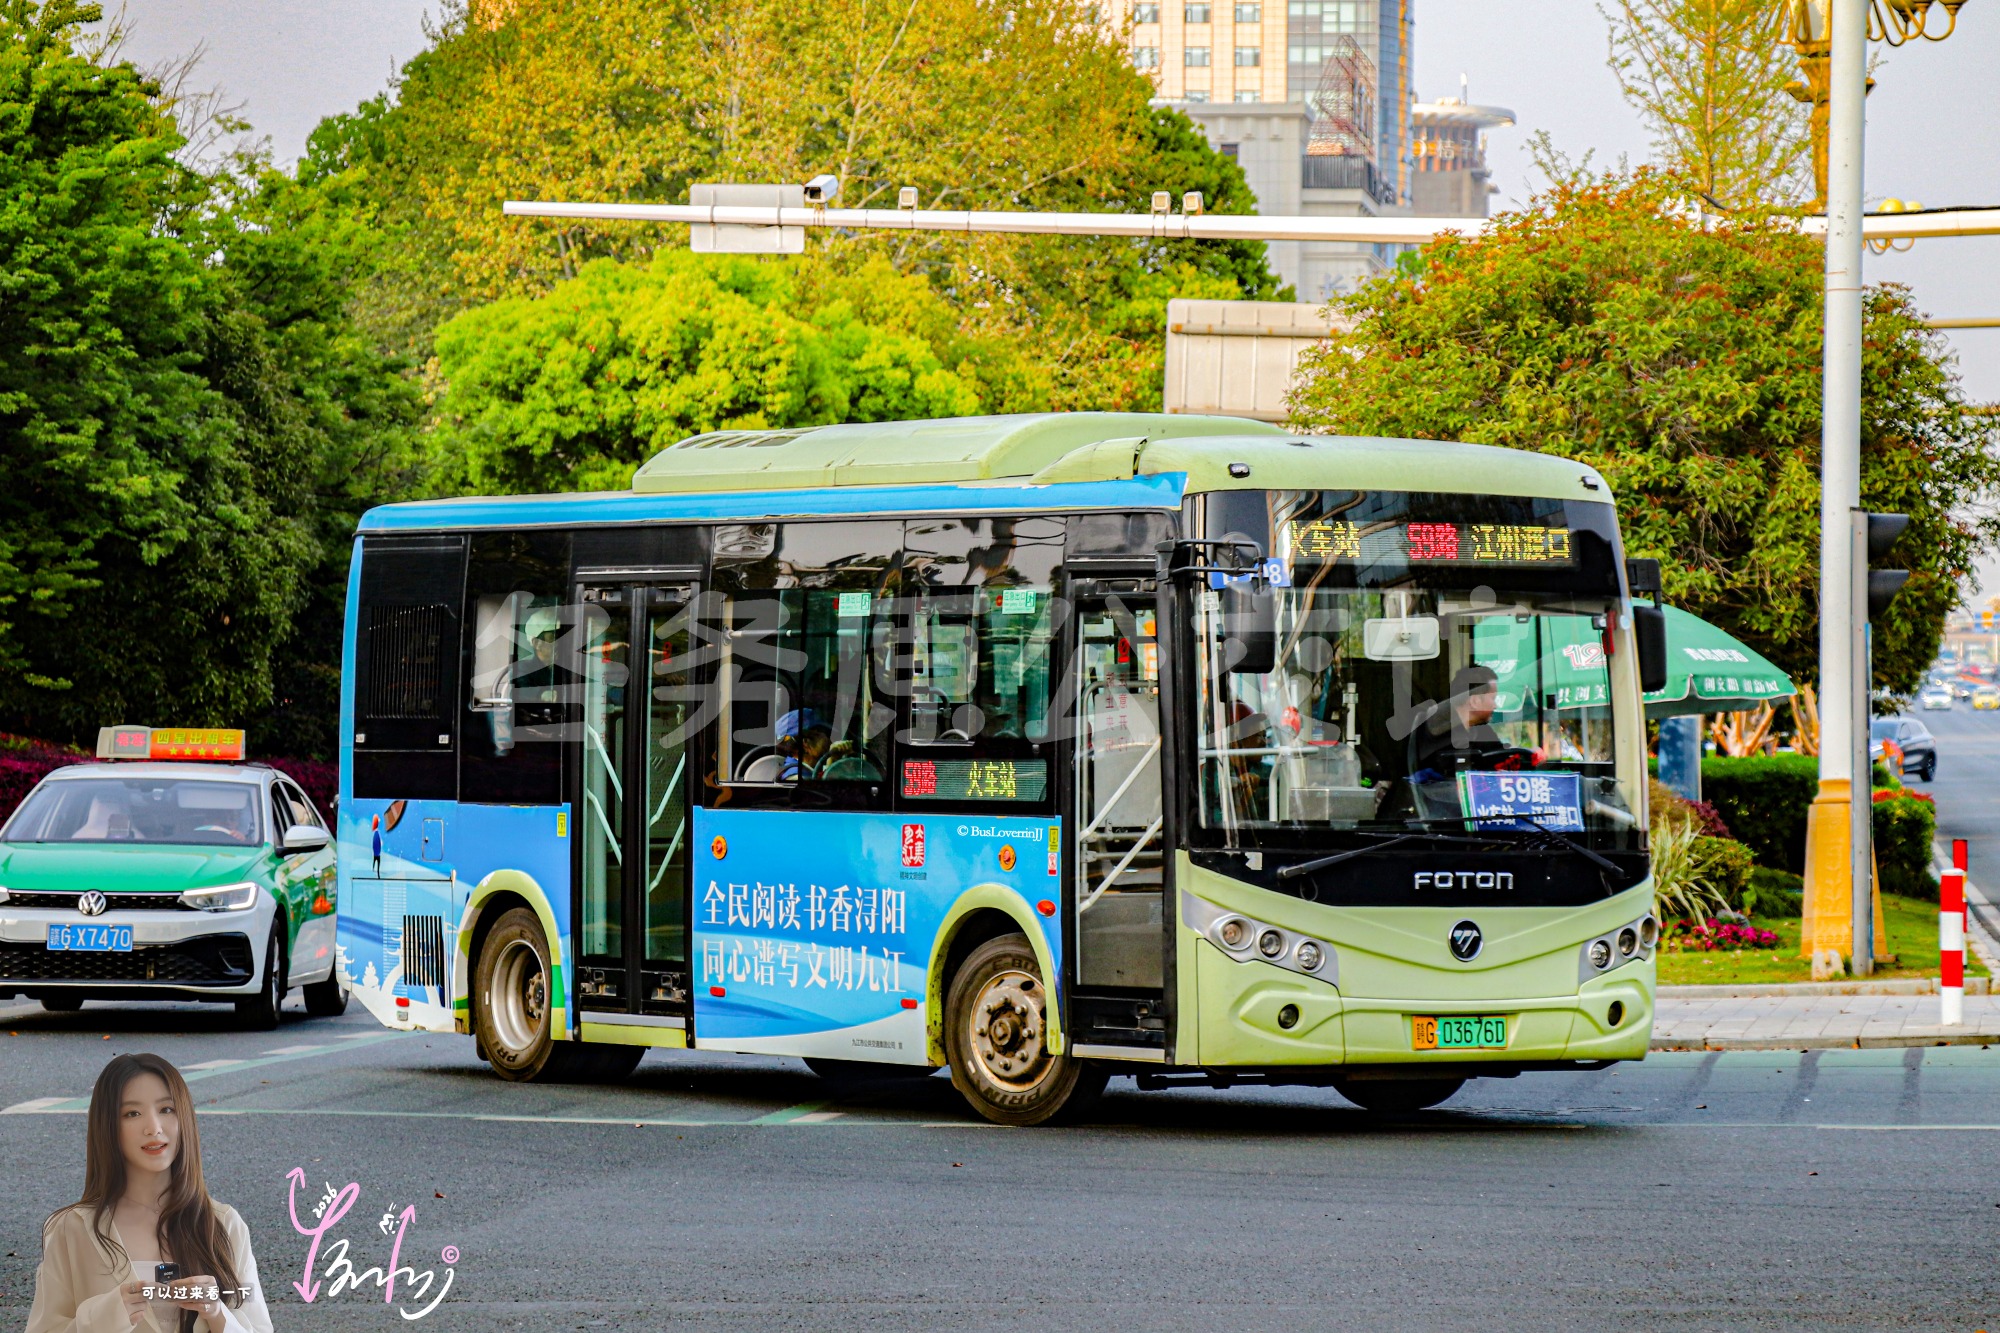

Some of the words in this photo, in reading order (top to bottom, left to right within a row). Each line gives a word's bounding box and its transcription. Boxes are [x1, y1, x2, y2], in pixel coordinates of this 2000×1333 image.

[1407, 522, 1460, 559] 59路
[1471, 524, 1570, 561] 江州渡口
[156, 731, 236, 746] 四星出租车
[903, 760, 938, 796] 59路
[966, 761, 1017, 798] 火车站
[1499, 777, 1552, 804] 59路
[1413, 871, 1514, 890] FOTON
